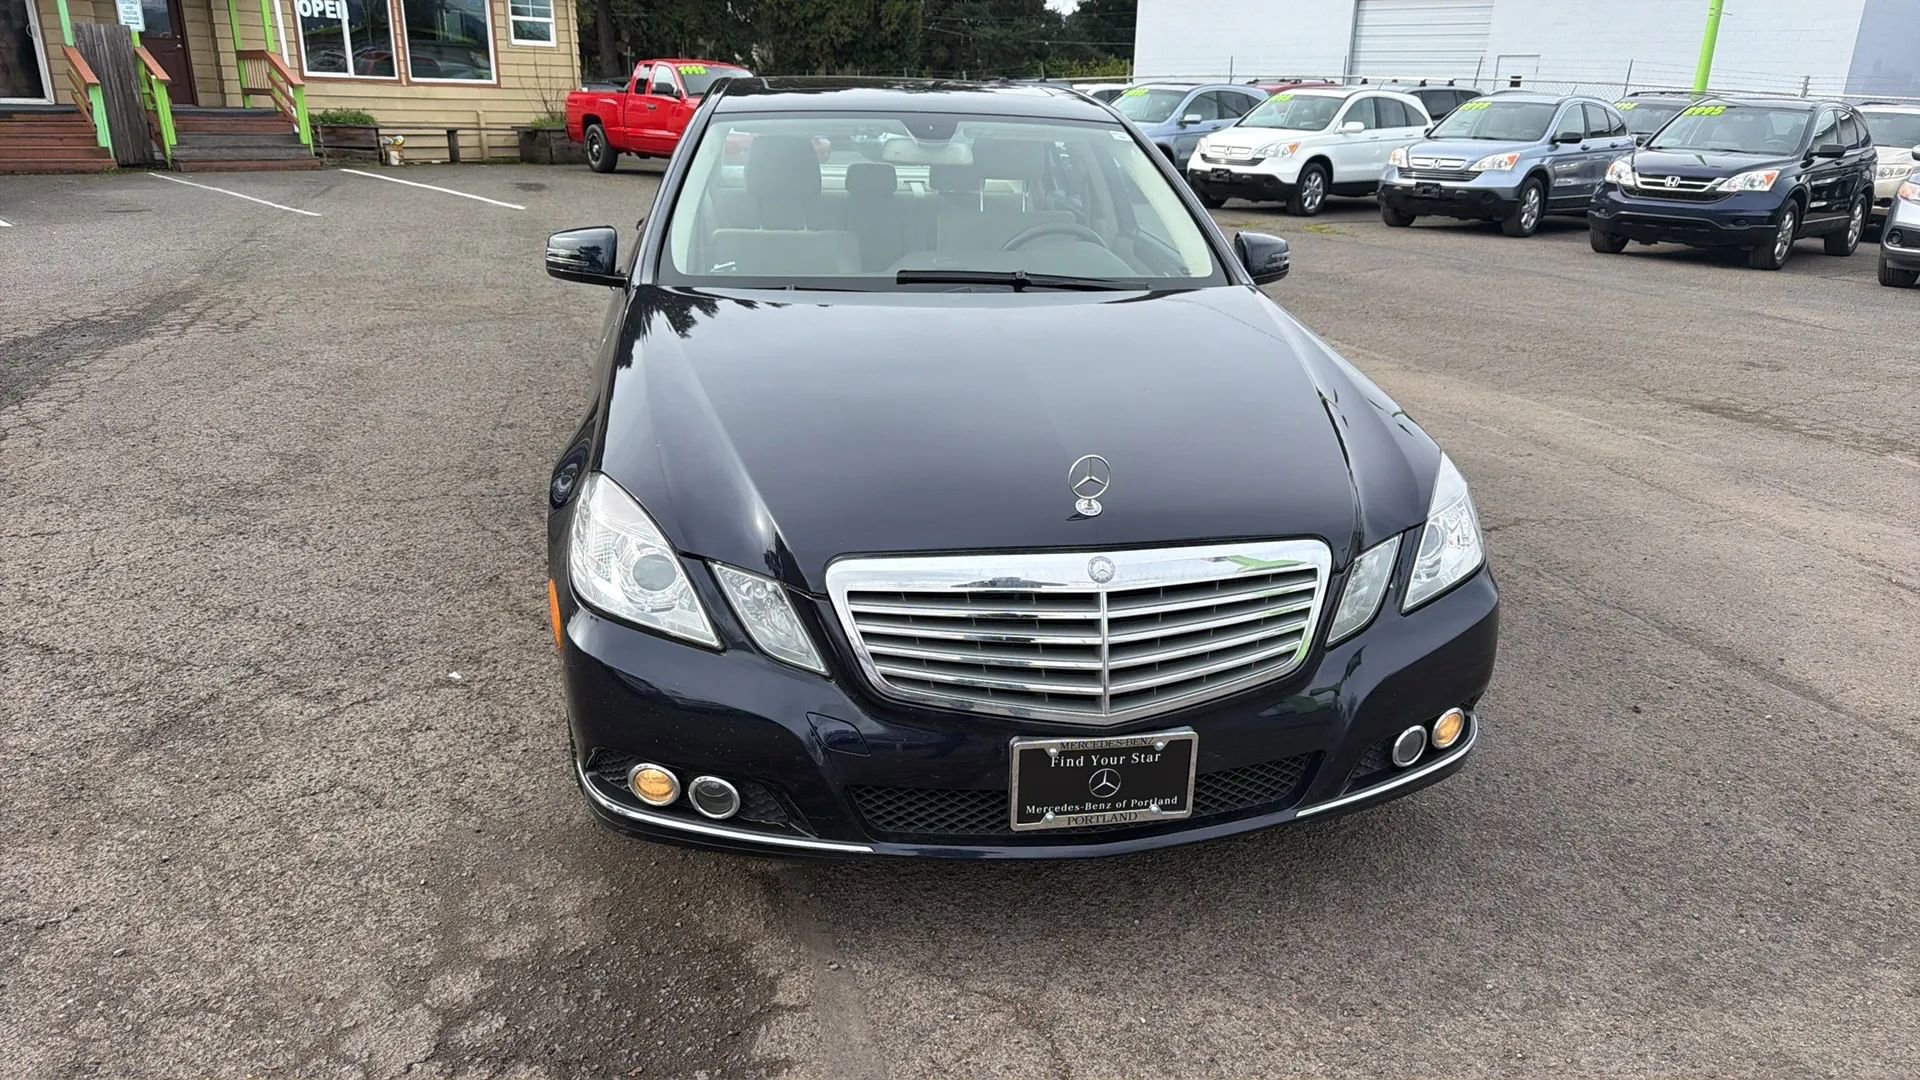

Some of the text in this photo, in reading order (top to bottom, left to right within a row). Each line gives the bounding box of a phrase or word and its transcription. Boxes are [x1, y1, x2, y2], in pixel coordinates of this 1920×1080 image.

[1060, 737, 1155, 750] MERCEDES-BENZ
[1051, 752, 1162, 768] Find Your Star
[1026, 795, 1178, 815] Mercedes-Benz of Portland
[1067, 812, 1138, 826] PORTLAND
